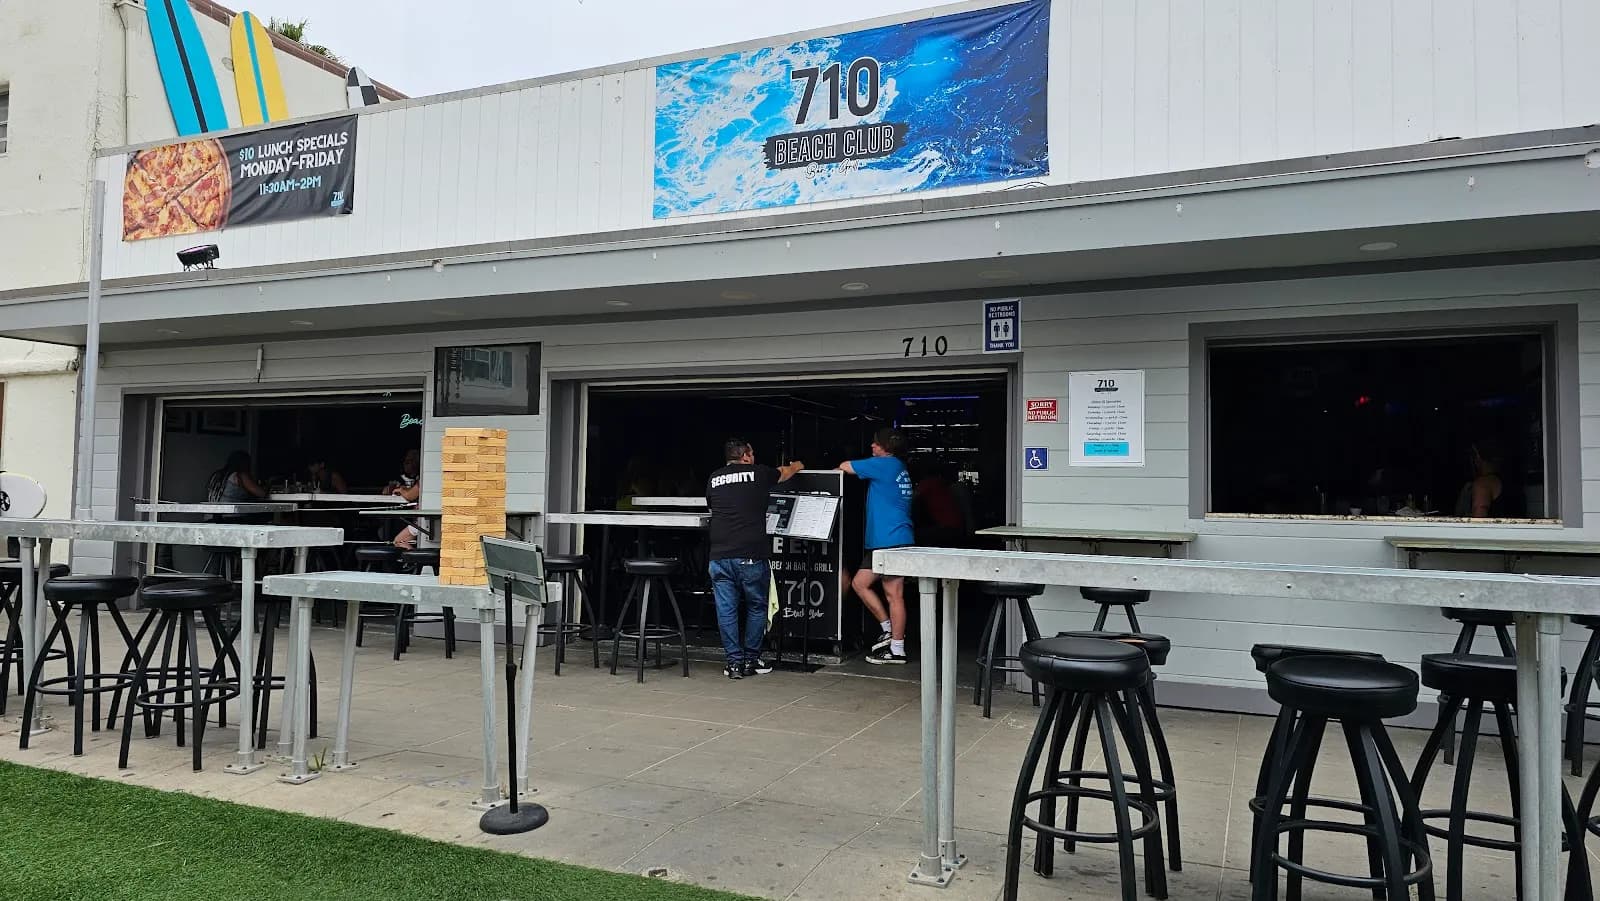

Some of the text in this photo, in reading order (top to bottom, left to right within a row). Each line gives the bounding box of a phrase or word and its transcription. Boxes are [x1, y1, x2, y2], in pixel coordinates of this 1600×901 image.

[791, 56, 880, 125] 710
[239, 131, 348, 161] $10 LUNCH SPECIALS
[774, 125, 894, 166] BEACH CLUB
[240, 149, 345, 178] MONDAY-FRIDAY
[259, 175, 322, 196] 11:30AM-2PM
[902, 335, 948, 357] 710
[1097, 379, 1115, 388] 710
[711, 471, 755, 489] SECURITY
[814, 562, 833, 573] GRILL
[784, 577, 825, 607] 710
